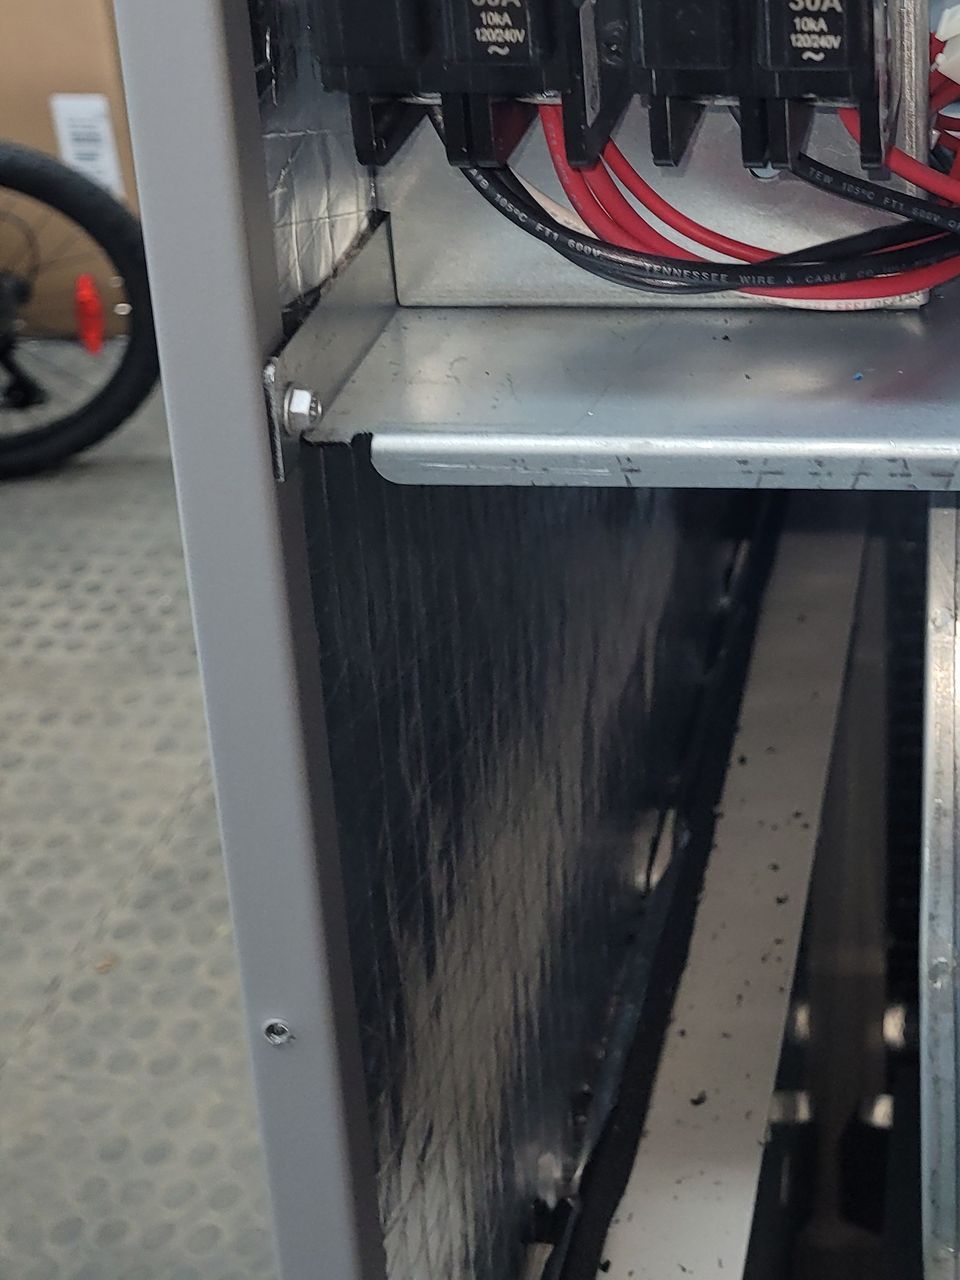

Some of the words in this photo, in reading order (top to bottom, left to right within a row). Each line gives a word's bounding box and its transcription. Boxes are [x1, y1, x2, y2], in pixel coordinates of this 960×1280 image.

[479, 11, 513, 27] 10kA
[793, 16, 828, 33] 10kA
[808, 166, 832, 185] TEW
[535, 222, 560, 243] FT1
[643, 263, 729, 284] TENNESSEE
[738, 274, 776, 286] WIRE
[805, 272, 847, 284] CABLE
